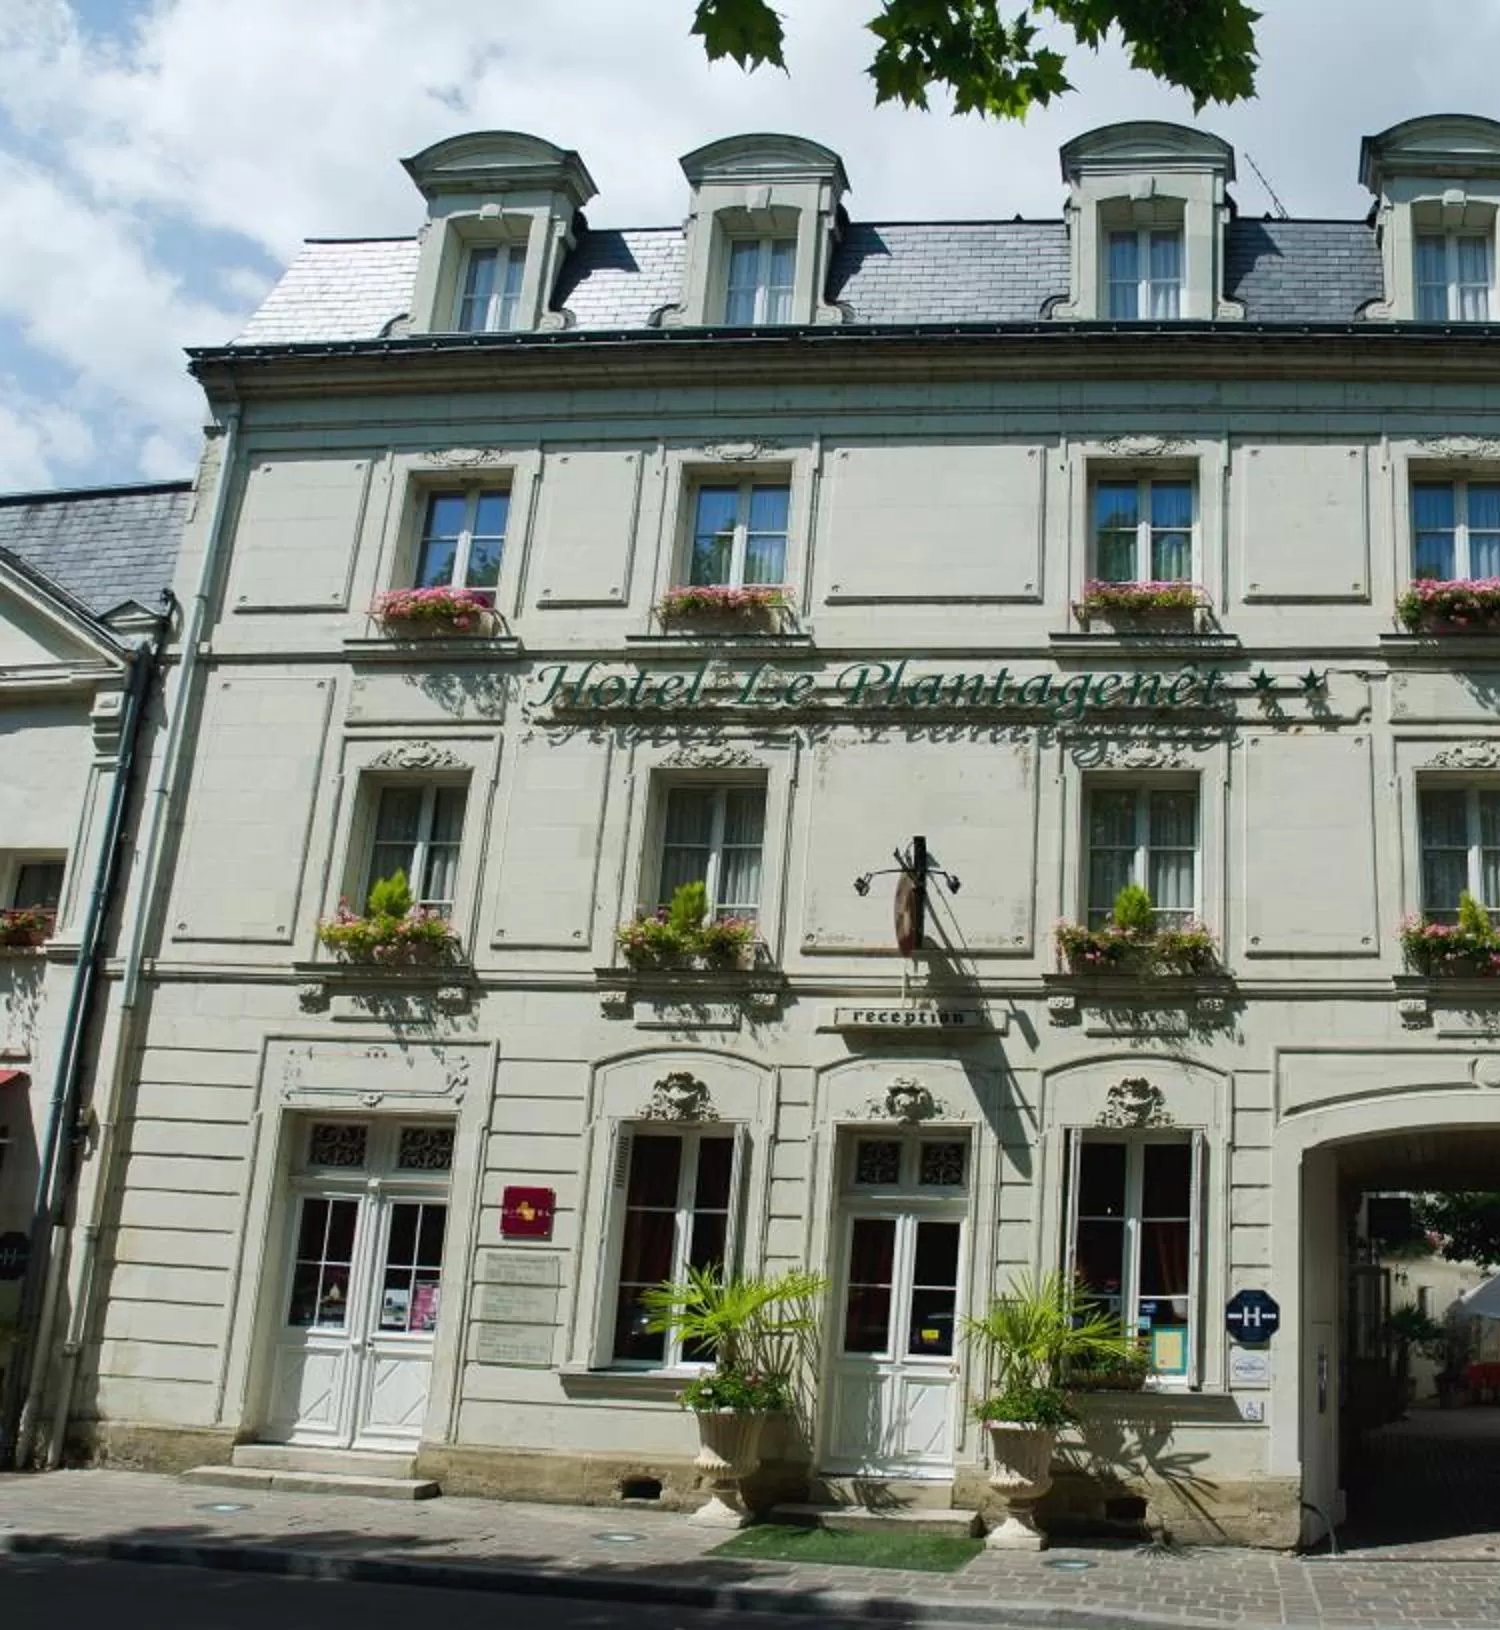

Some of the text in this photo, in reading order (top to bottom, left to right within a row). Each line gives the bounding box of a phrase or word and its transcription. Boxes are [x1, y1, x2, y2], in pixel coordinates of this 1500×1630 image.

[535, 658, 1224, 722] Hotel Le Plantagenêt
[1243, 1305, 1261, 1327] H
